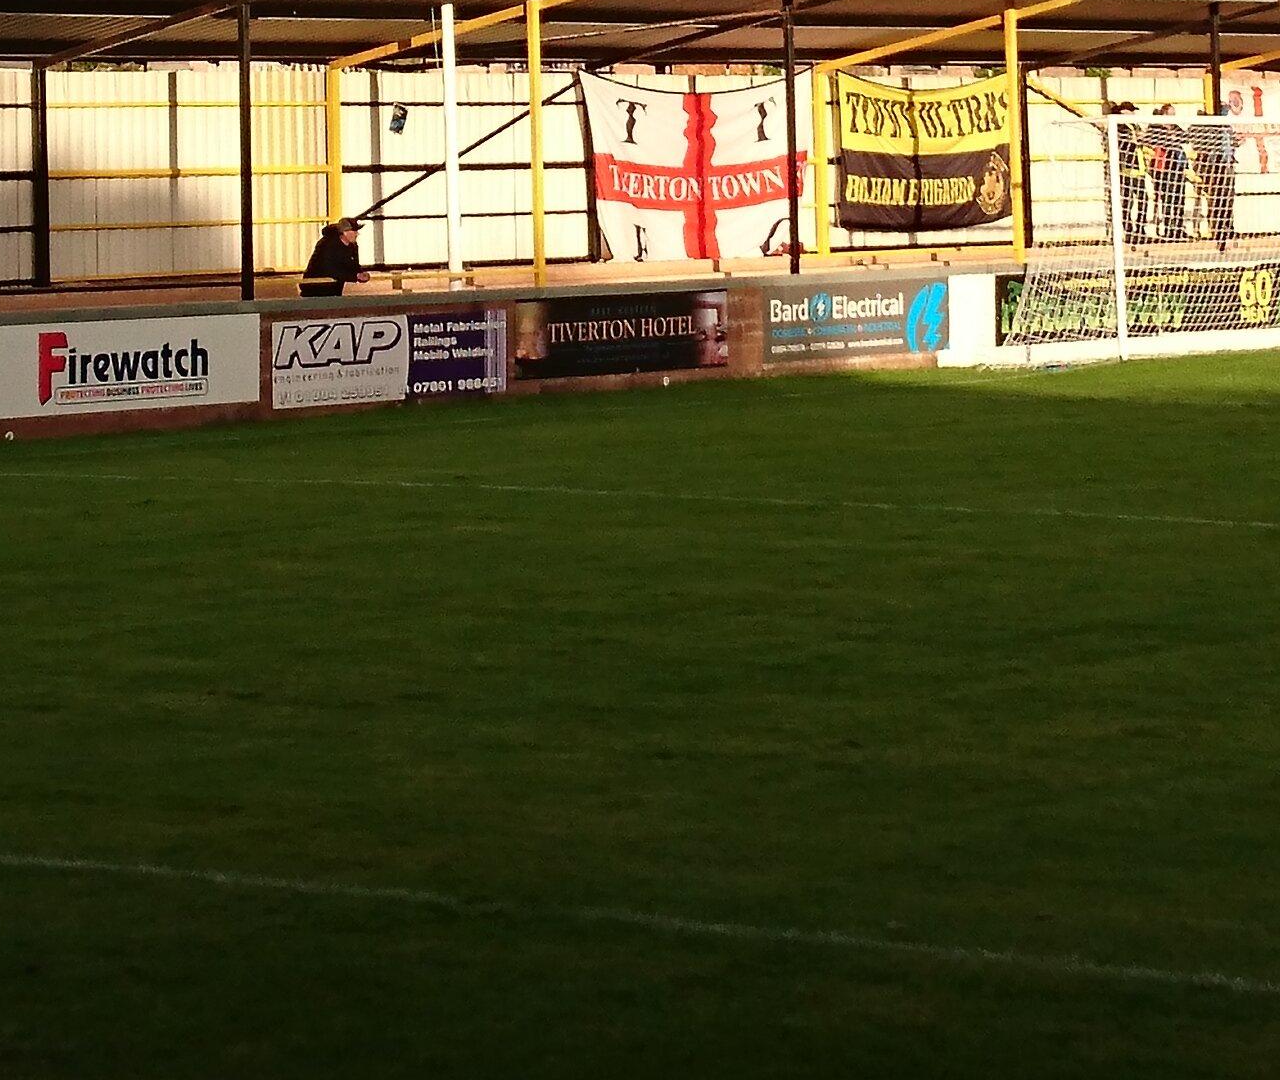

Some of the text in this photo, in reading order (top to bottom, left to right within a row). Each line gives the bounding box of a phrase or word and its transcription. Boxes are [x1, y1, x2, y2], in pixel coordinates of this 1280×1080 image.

[707, 166, 785, 201] TOWN
[770, 292, 904, 323] Bard Electrical
[274, 320, 402, 370] KAP
[547, 315, 697, 344] TIVERTON HOTEL
[38, 332, 209, 406] Firewatch
